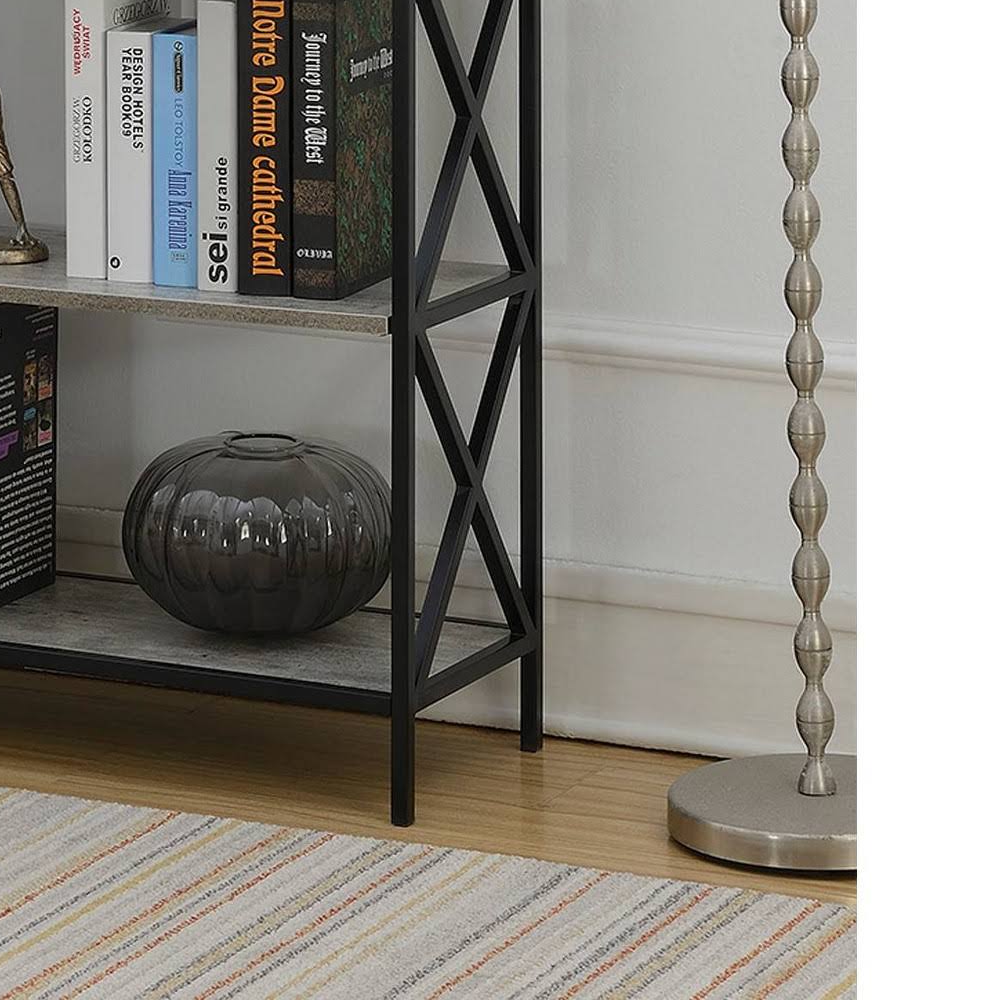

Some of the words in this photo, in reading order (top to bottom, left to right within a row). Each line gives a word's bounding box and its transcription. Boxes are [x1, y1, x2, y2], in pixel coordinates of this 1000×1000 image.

[251, 0, 285, 67] Notre
[122, 48, 132, 81] YEAR
[133, 48, 144, 94] DESIGN
[300, 31, 328, 86] Journey
[174, 97, 184, 118] LEO
[251, 76, 285, 147] Dame
[305, 89, 323, 102] to
[305, 104, 326, 126] the
[173, 120, 184, 167] TOLSTOY
[304, 128, 327, 165] West
[168, 169, 192, 197] Anna
[214, 157, 230, 211] grande
[168, 199, 192, 250] Karenina
[215, 216, 228, 229] si
[251, 155, 285, 276] cathedral
[202, 233, 228, 284] sei
